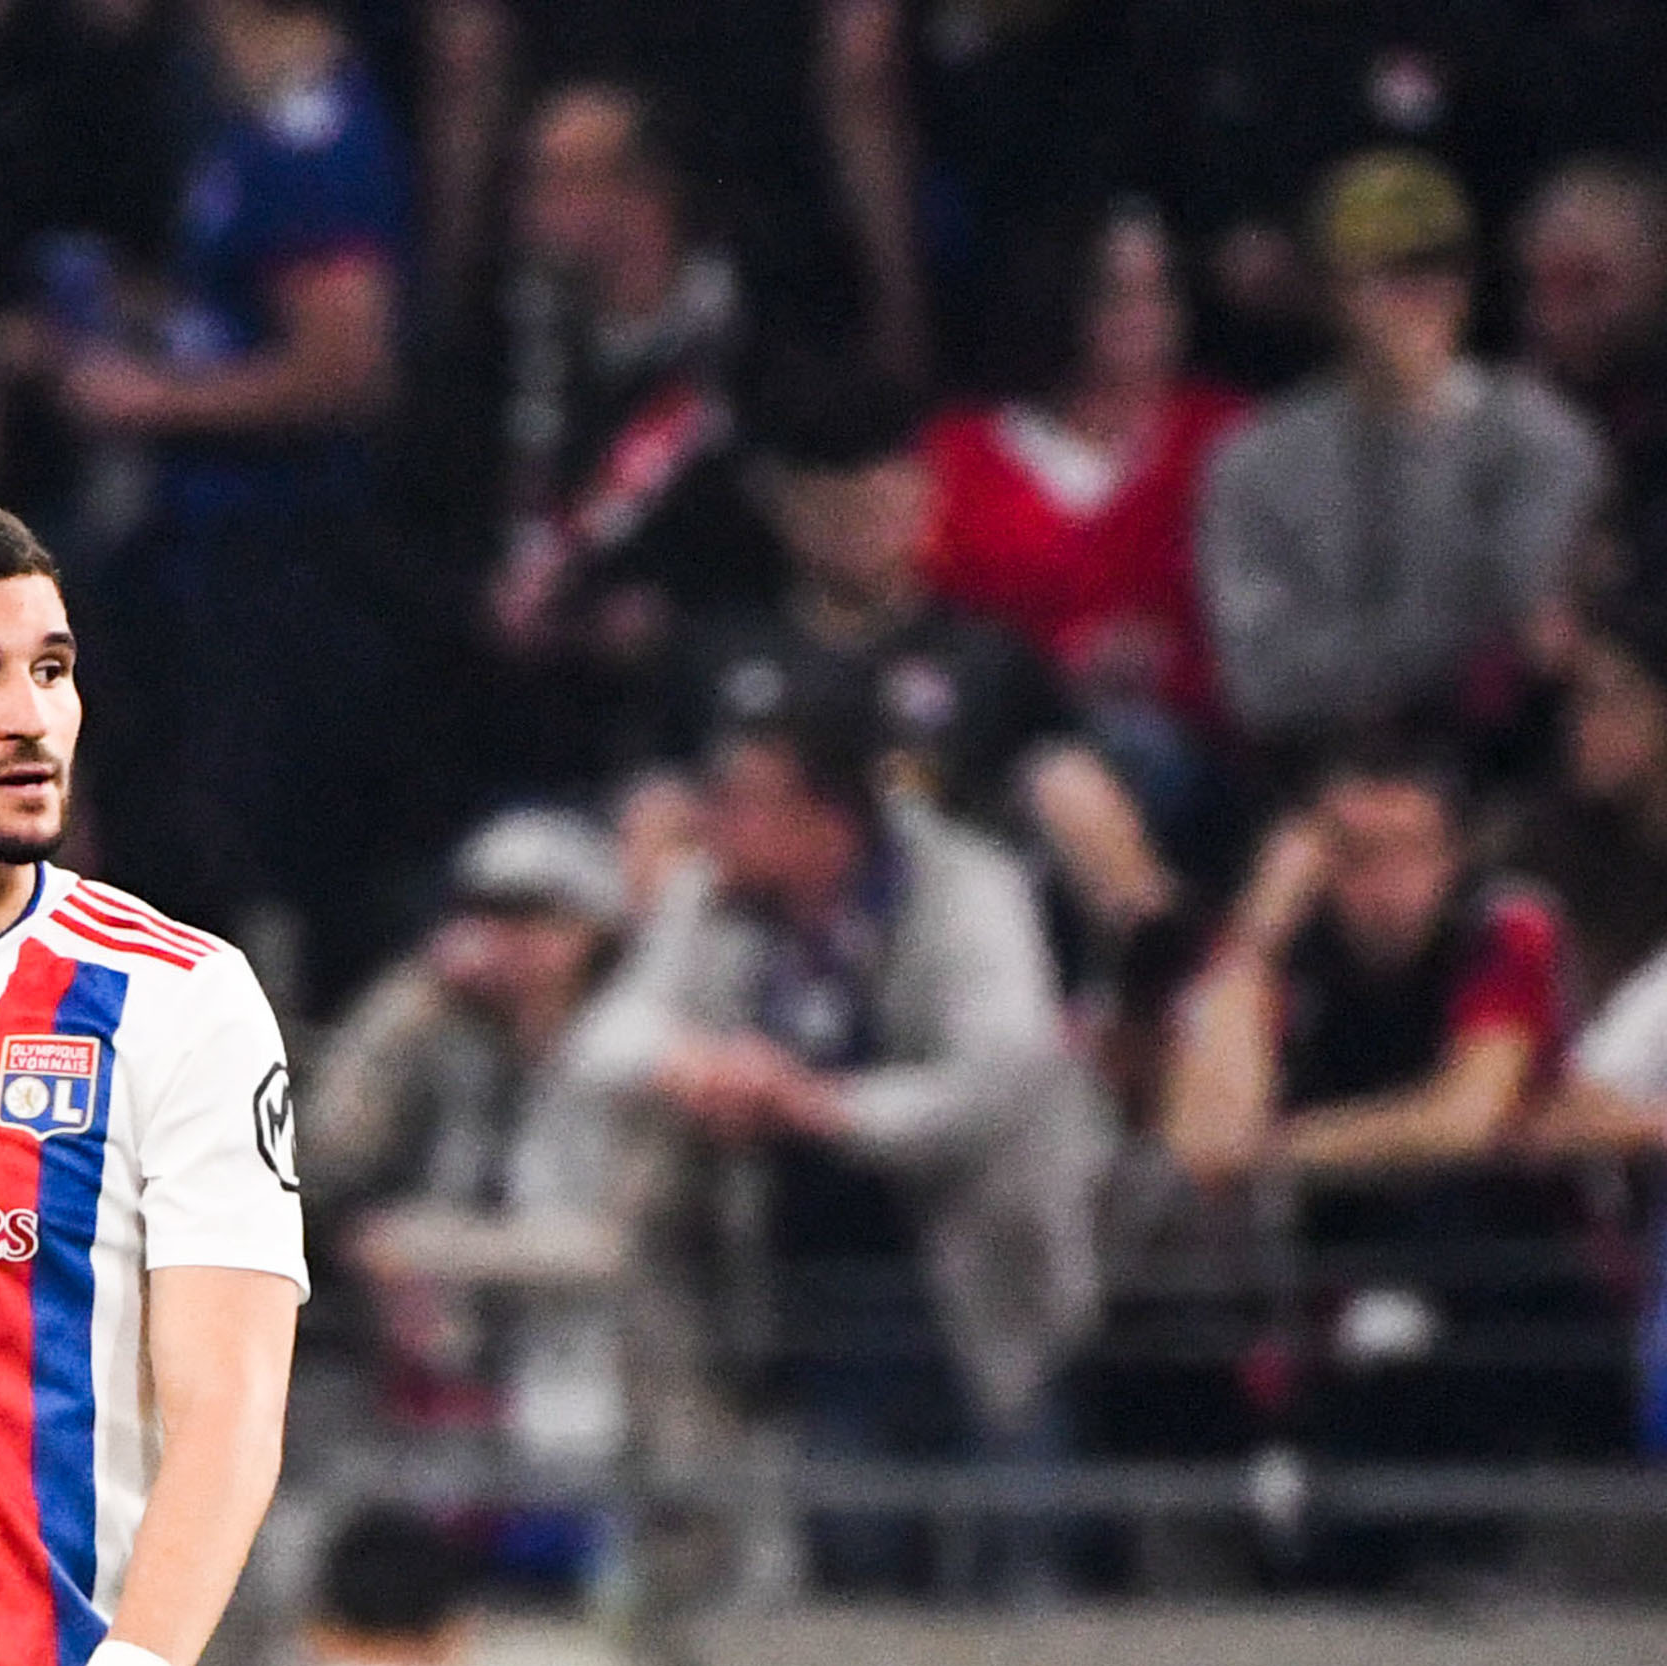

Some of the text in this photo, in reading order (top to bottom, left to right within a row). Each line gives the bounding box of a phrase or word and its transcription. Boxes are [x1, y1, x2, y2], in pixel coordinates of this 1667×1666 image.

[9, 1043, 90, 1059] OLYMPIQUE
[8, 1056, 89, 1073] LYONNAIS
[4, 1076, 84, 1124] OL
